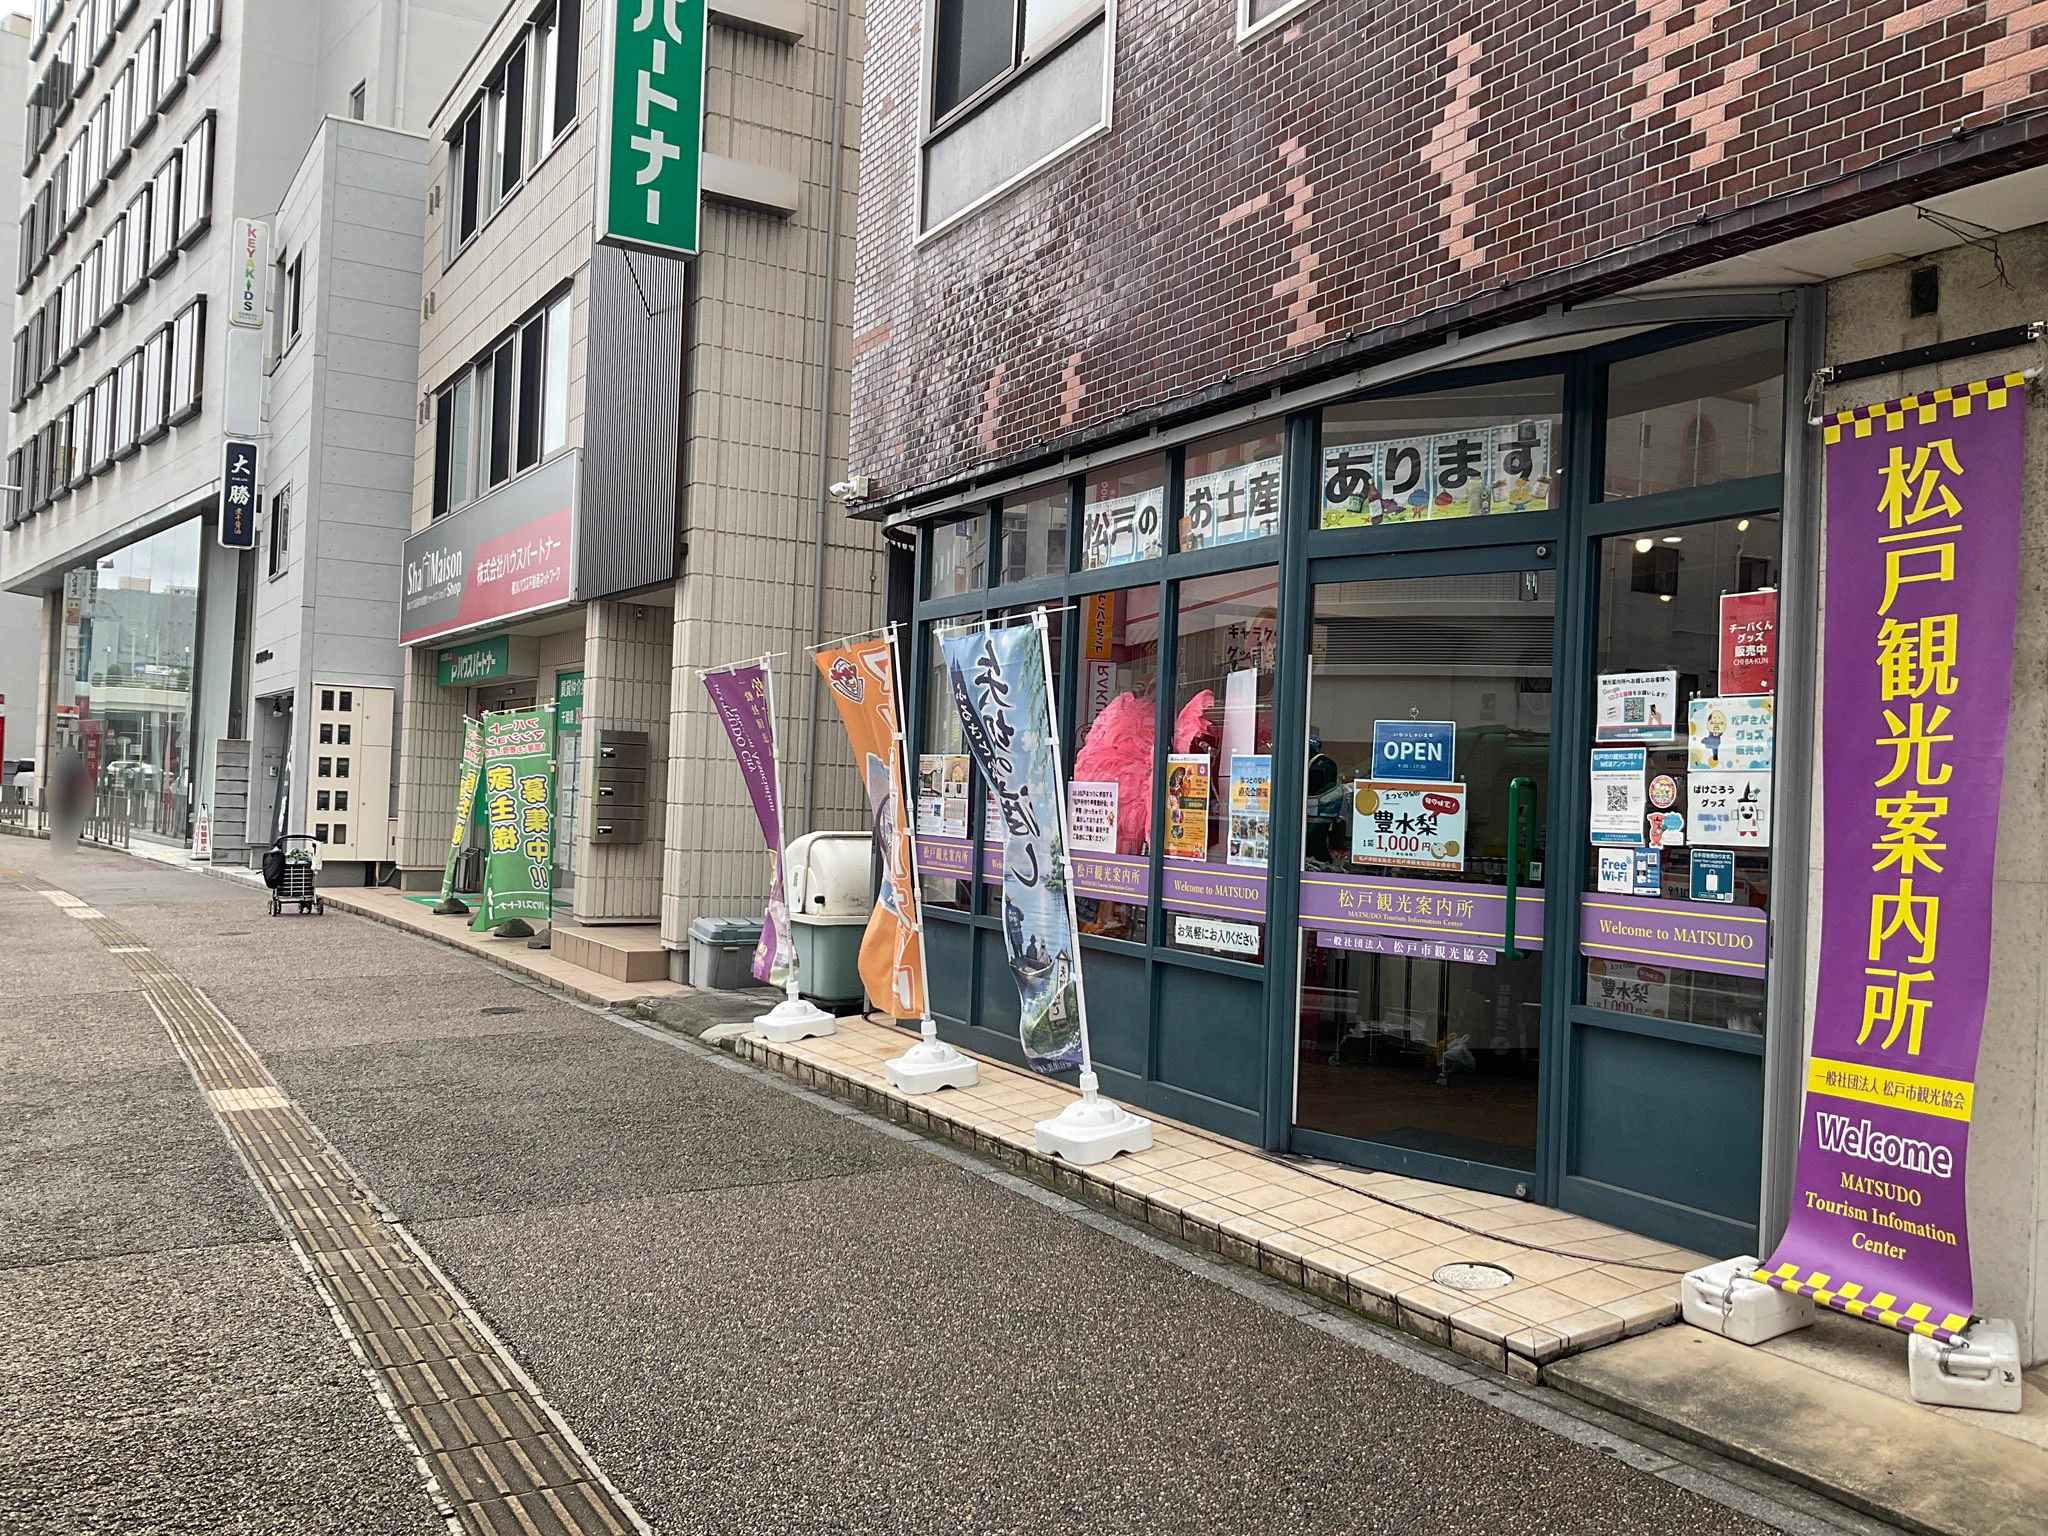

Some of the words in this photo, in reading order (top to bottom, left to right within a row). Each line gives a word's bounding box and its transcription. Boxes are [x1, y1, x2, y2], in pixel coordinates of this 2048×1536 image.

[1084, 505, 1159, 551] 松戸の
[1188, 471, 1280, 530] お土産
[1325, 438, 1542, 505] あります
[477, 535, 561, 587] 株式会社ハウスパートナー
[446, 582, 462, 597] Shop
[1728, 620, 1774, 634] チーバくん
[1737, 631, 1765, 644] グッズ
[1734, 643, 1768, 658] 販売中
[1736, 730, 1764, 740] グッズ
[1383, 741, 1442, 761] OPEN
[1856, 438, 1965, 1056] 松戸観光案内所
[1701, 799, 1726, 808] グッズ
[1373, 810, 1438, 836] 豊水梨
[1376, 834, 1420, 853] 1,000
[1421, 842, 1431, 852] 円
[1077, 862, 1141, 885] 松戸観光案内所
[1601, 857, 1628, 871] Free
[1601, 870, 1628, 883] Wi-Fi
[1173, 879, 1204, 894] Welcome
[1205, 886, 1213, 895] to
[1214, 884, 1259, 901] MATSUDO
[1338, 888, 1475, 919] 松戸観光案内所
[1348, 910, 1382, 920] MATSUDO
[1383, 914, 1407, 923] Tourism
[1407, 916, 1442, 926] Information
[1443, 919, 1464, 927] Center
[1177, 924, 1258, 947] お気軽にお入りください
[1599, 919, 1653, 938] Welcome
[1656, 929, 1669, 940] to
[1673, 927, 1754, 950] MATSUDO
[1322, 935, 1385, 951] 一般社団法人
[1393, 942, 1489, 963] 松戸市観光協会
[1600, 977, 1649, 1004] 豊水梨
[1815, 1070, 1879, 1094] 一般社団法人
[1883, 1079, 1966, 1111] 松戸市観光協会
[1816, 1111, 1953, 1178] Welcome
[1840, 1172, 1922, 1207] MATSUDO
[1805, 1190, 1868, 1222] Tourism
[1872, 1208, 1958, 1246] Infomation
[1851, 1232, 1907, 1260] Center
